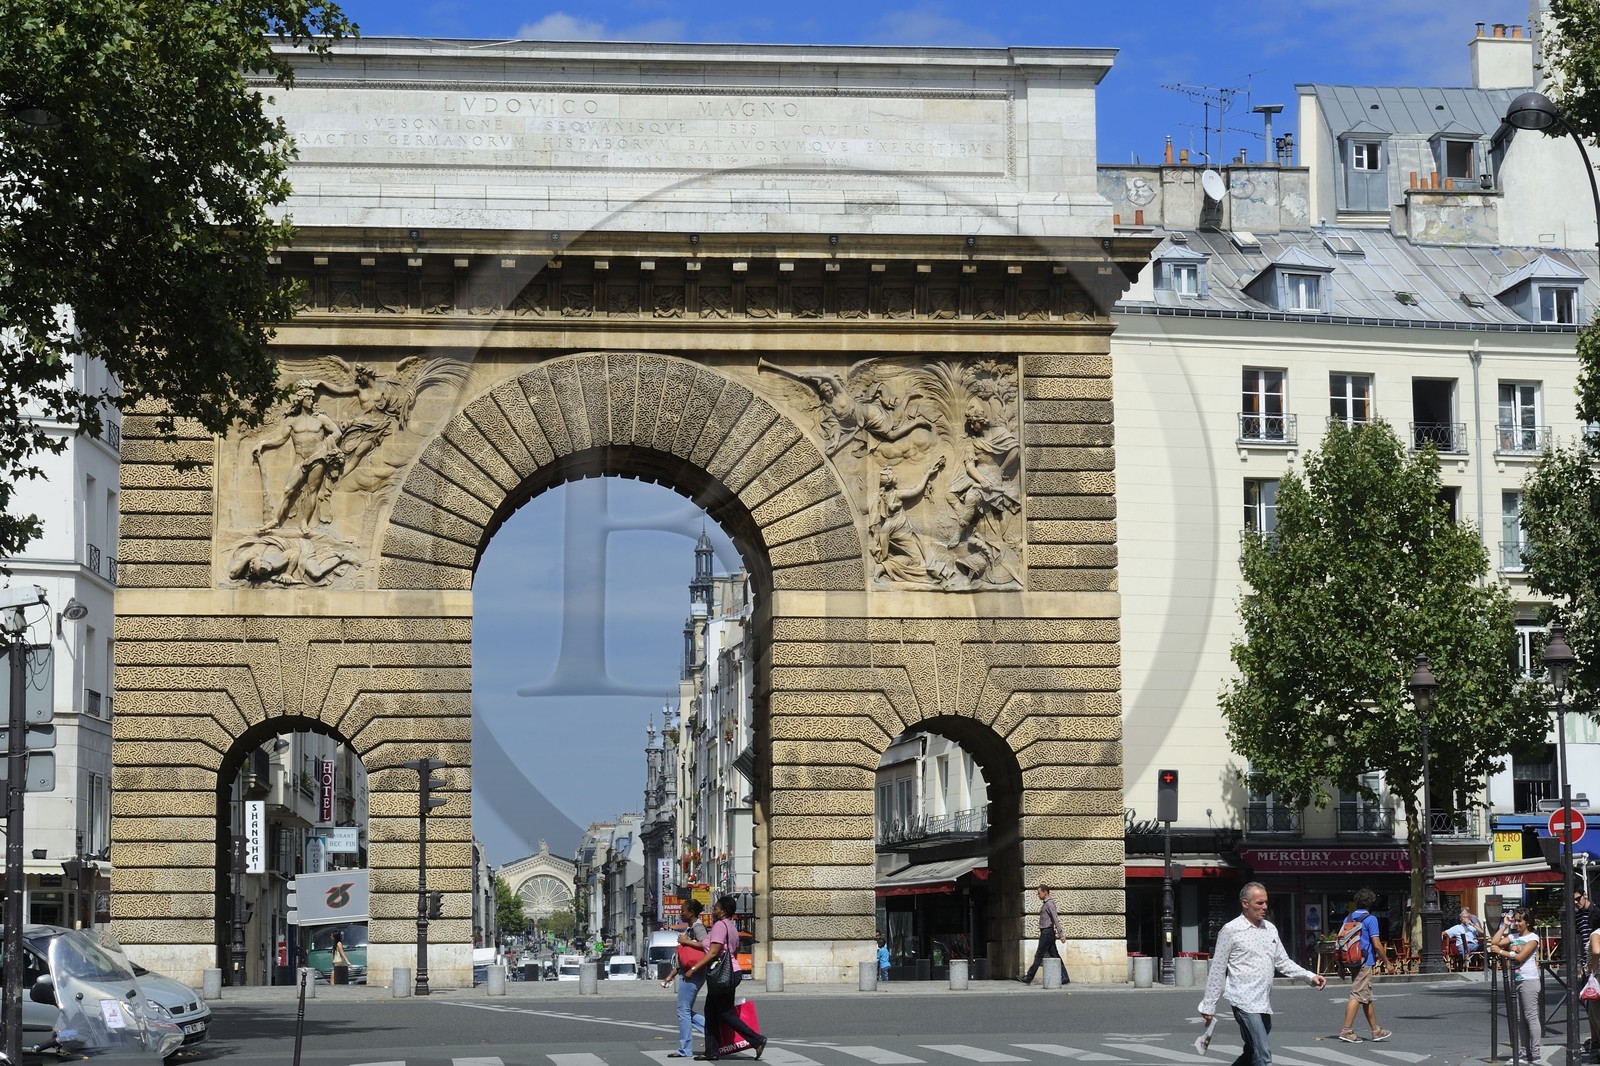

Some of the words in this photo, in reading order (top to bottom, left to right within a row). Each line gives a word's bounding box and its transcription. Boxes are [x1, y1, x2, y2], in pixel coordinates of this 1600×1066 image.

[444, 96, 598, 116] LVDOVICO
[697, 101, 799, 117] MAGNO
[730, 124, 757, 136] BIS
[801, 124, 870, 136] CAPTIS
[299, 132, 369, 145] RACTIS
[388, 134, 526, 149] GERMANORVM
[866, 141, 993, 155] EXERCITIBVS
[323, 762, 332, 820] HOTEL
[250, 803, 259, 871] SHANGHAI
[1495, 832, 1520, 843] AFRO
[1257, 851, 1332, 861] MERCURY
[1350, 852, 1410, 862] COIFFUR
